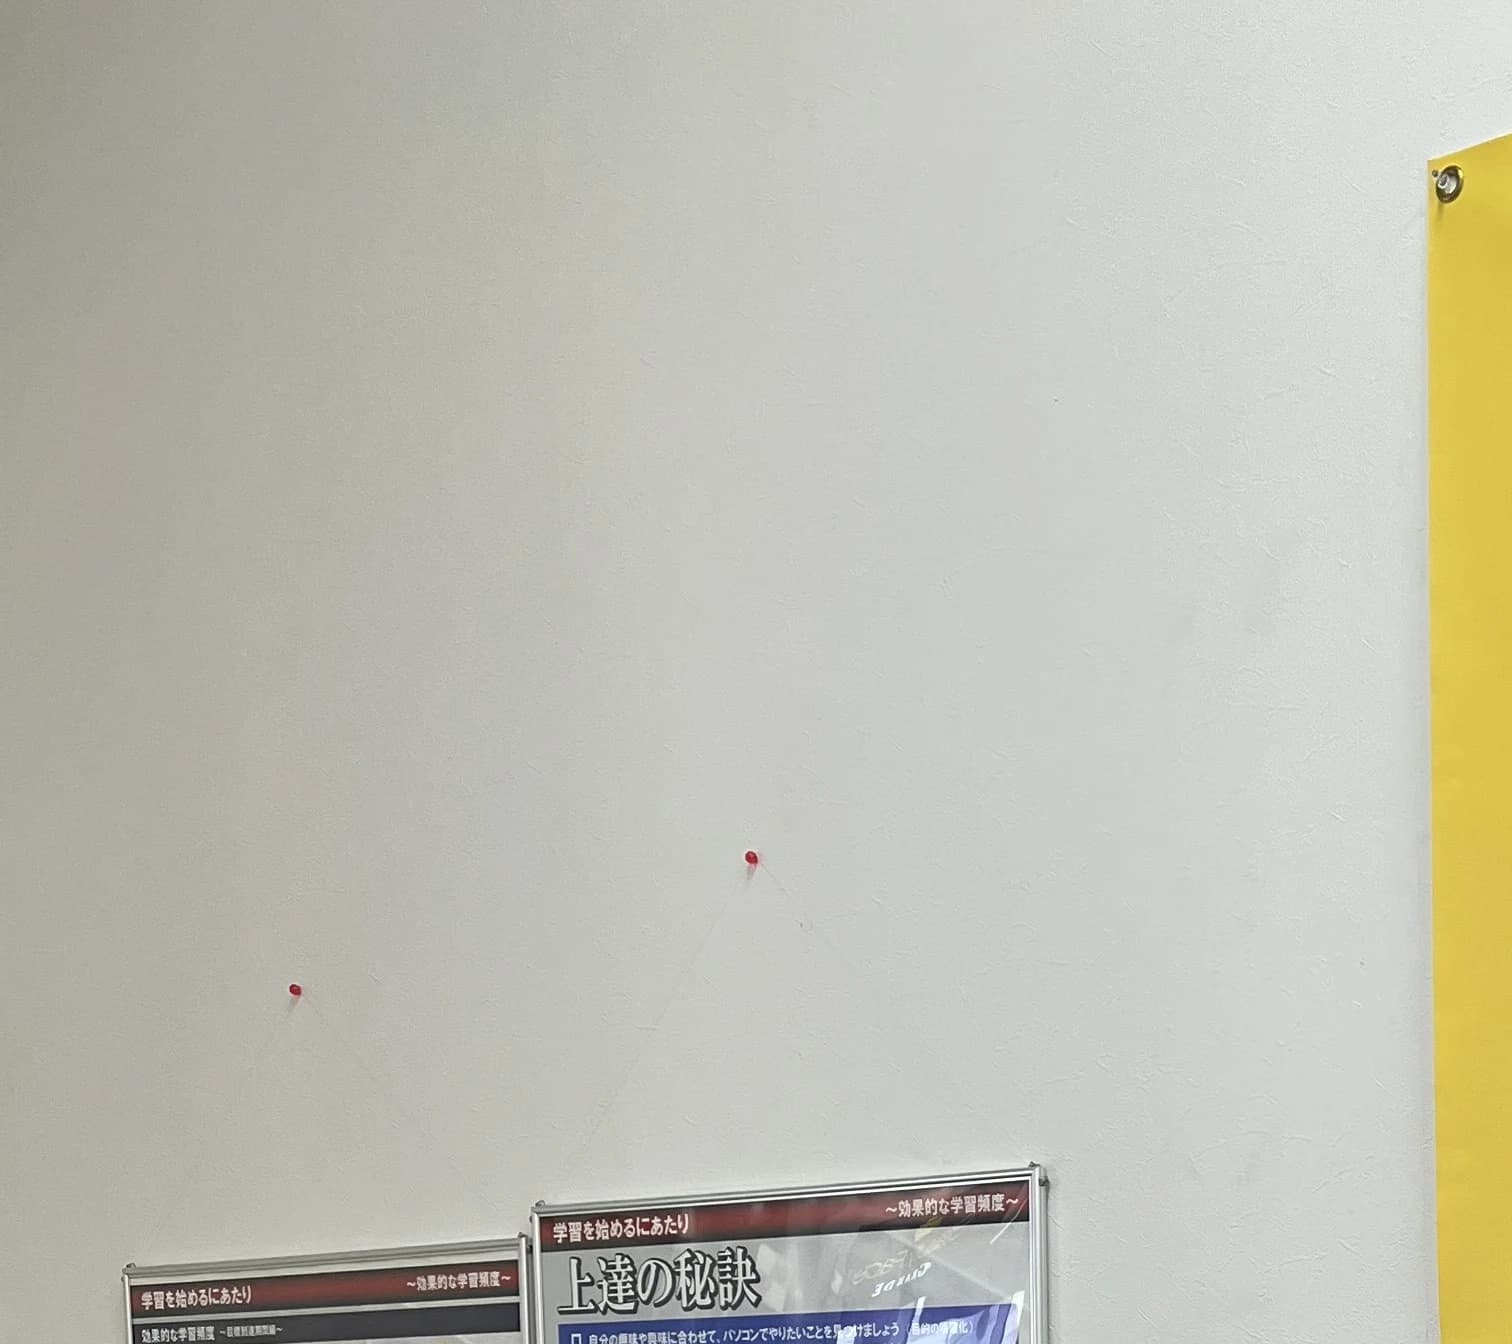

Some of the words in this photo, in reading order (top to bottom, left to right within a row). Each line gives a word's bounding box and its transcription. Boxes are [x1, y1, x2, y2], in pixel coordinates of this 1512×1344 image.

[553, 1213, 690, 1244] 学習を始めるにあたり
[557, 1246, 762, 1315] 上達の秘訣
[141, 1285, 252, 1310] 学習を始めるにあたり
[141, 1326, 215, 1344] 効果的な学習頻度
